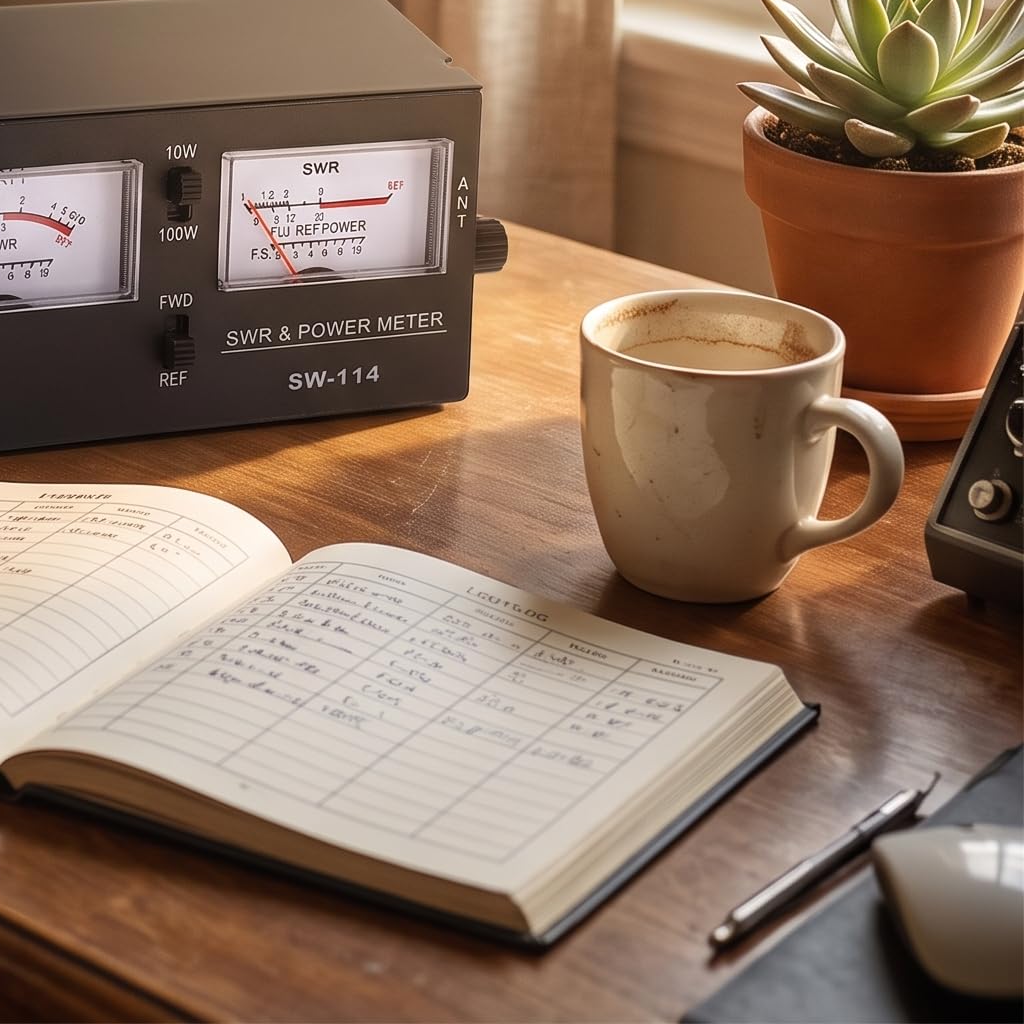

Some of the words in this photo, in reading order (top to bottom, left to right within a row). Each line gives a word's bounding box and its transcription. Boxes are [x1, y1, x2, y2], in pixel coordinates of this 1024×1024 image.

[165, 144, 198, 160] 10W
[302, 161, 340, 176] SWR
[20, 196, 26, 205] 2
[0, 222, 7, 232] 3
[158, 225, 199, 242] 100W
[293, 251, 299, 259] 3
[308, 250, 314, 258] 4
[159, 292, 193, 310] FWD
[226, 328, 272, 347] SWR
[278, 325, 291, 342] &
[298, 317, 371, 340] POWER
[377, 311, 444, 333] METER
[159, 370, 188, 388] REF
[288, 365, 380, 391] SW-114
